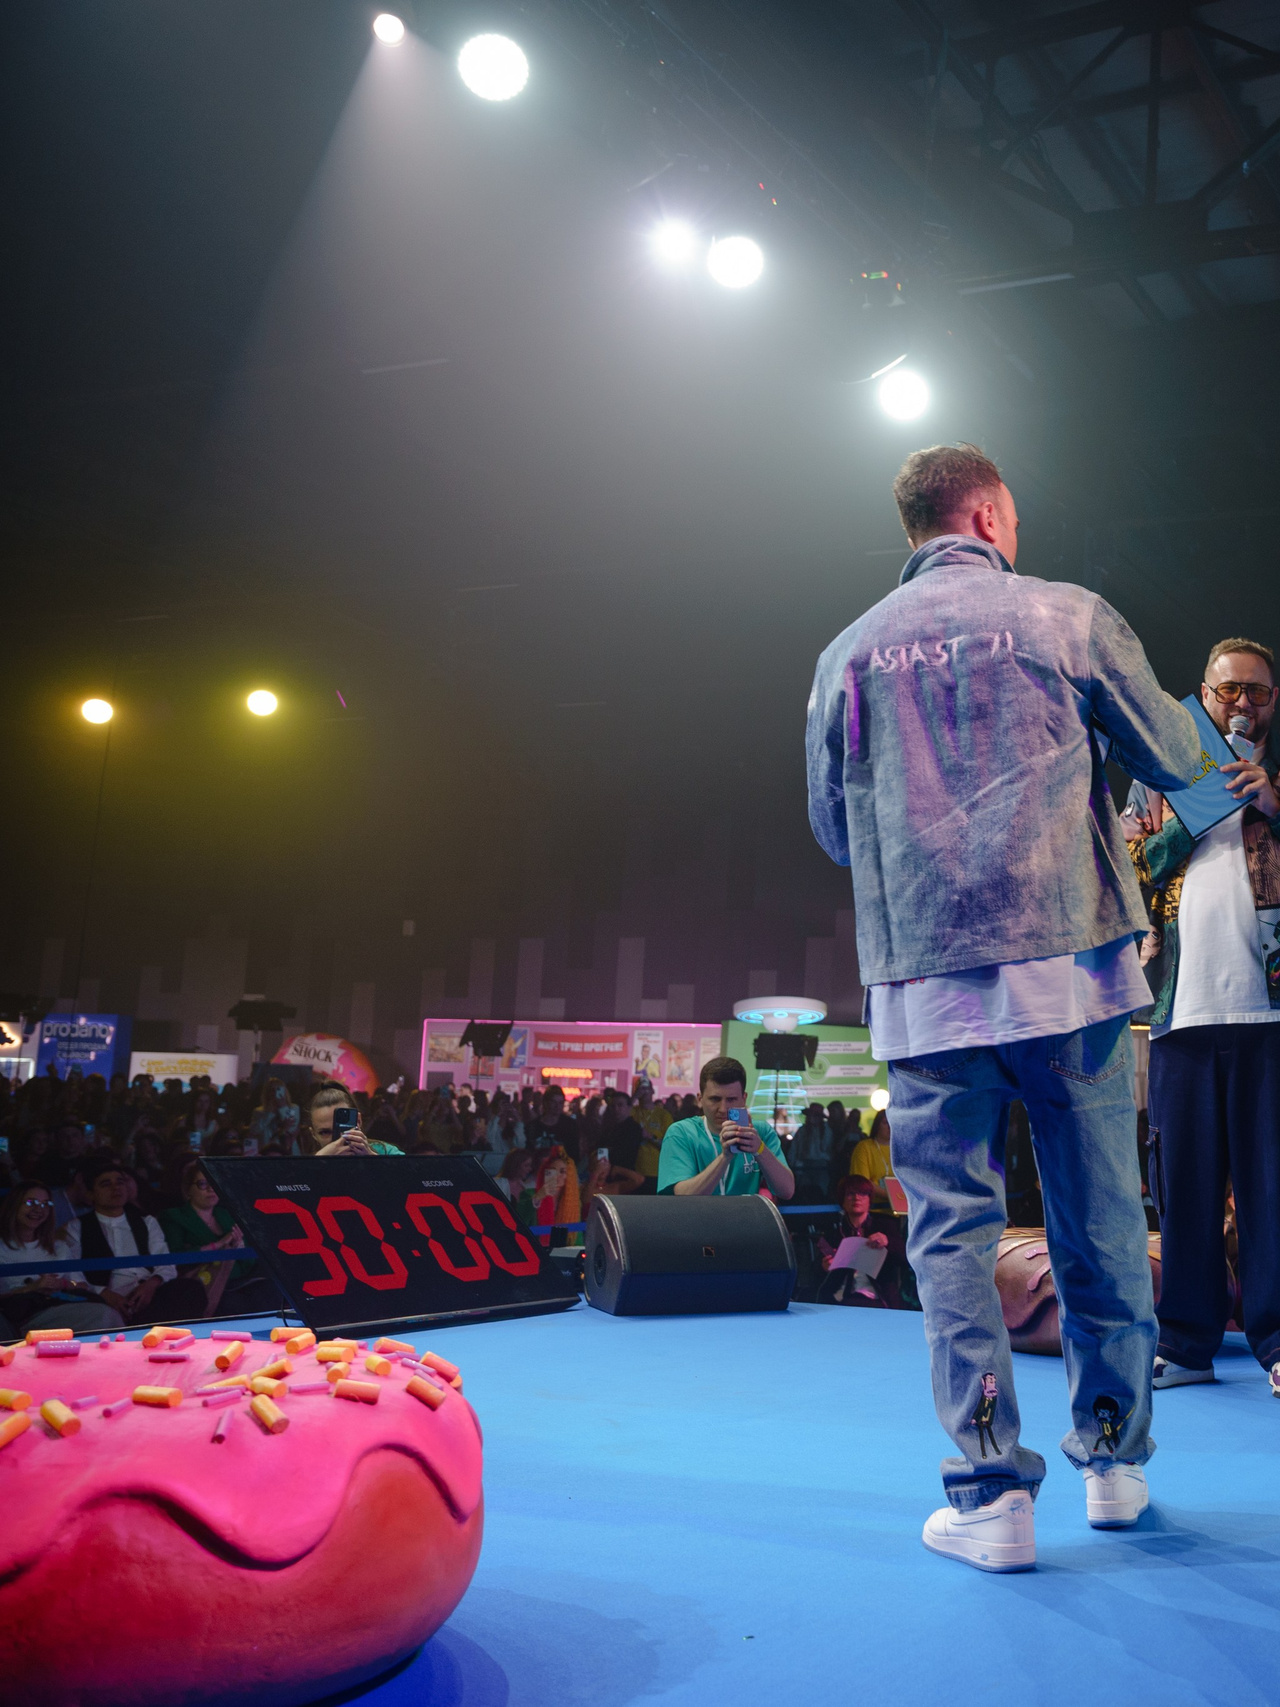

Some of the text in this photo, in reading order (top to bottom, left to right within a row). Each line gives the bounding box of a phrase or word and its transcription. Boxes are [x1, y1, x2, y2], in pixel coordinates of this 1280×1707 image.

[292, 1043, 332, 1063] SHOCK
[276, 1184, 311, 1192] MINUTES
[253, 1190, 540, 1297] 30:00
